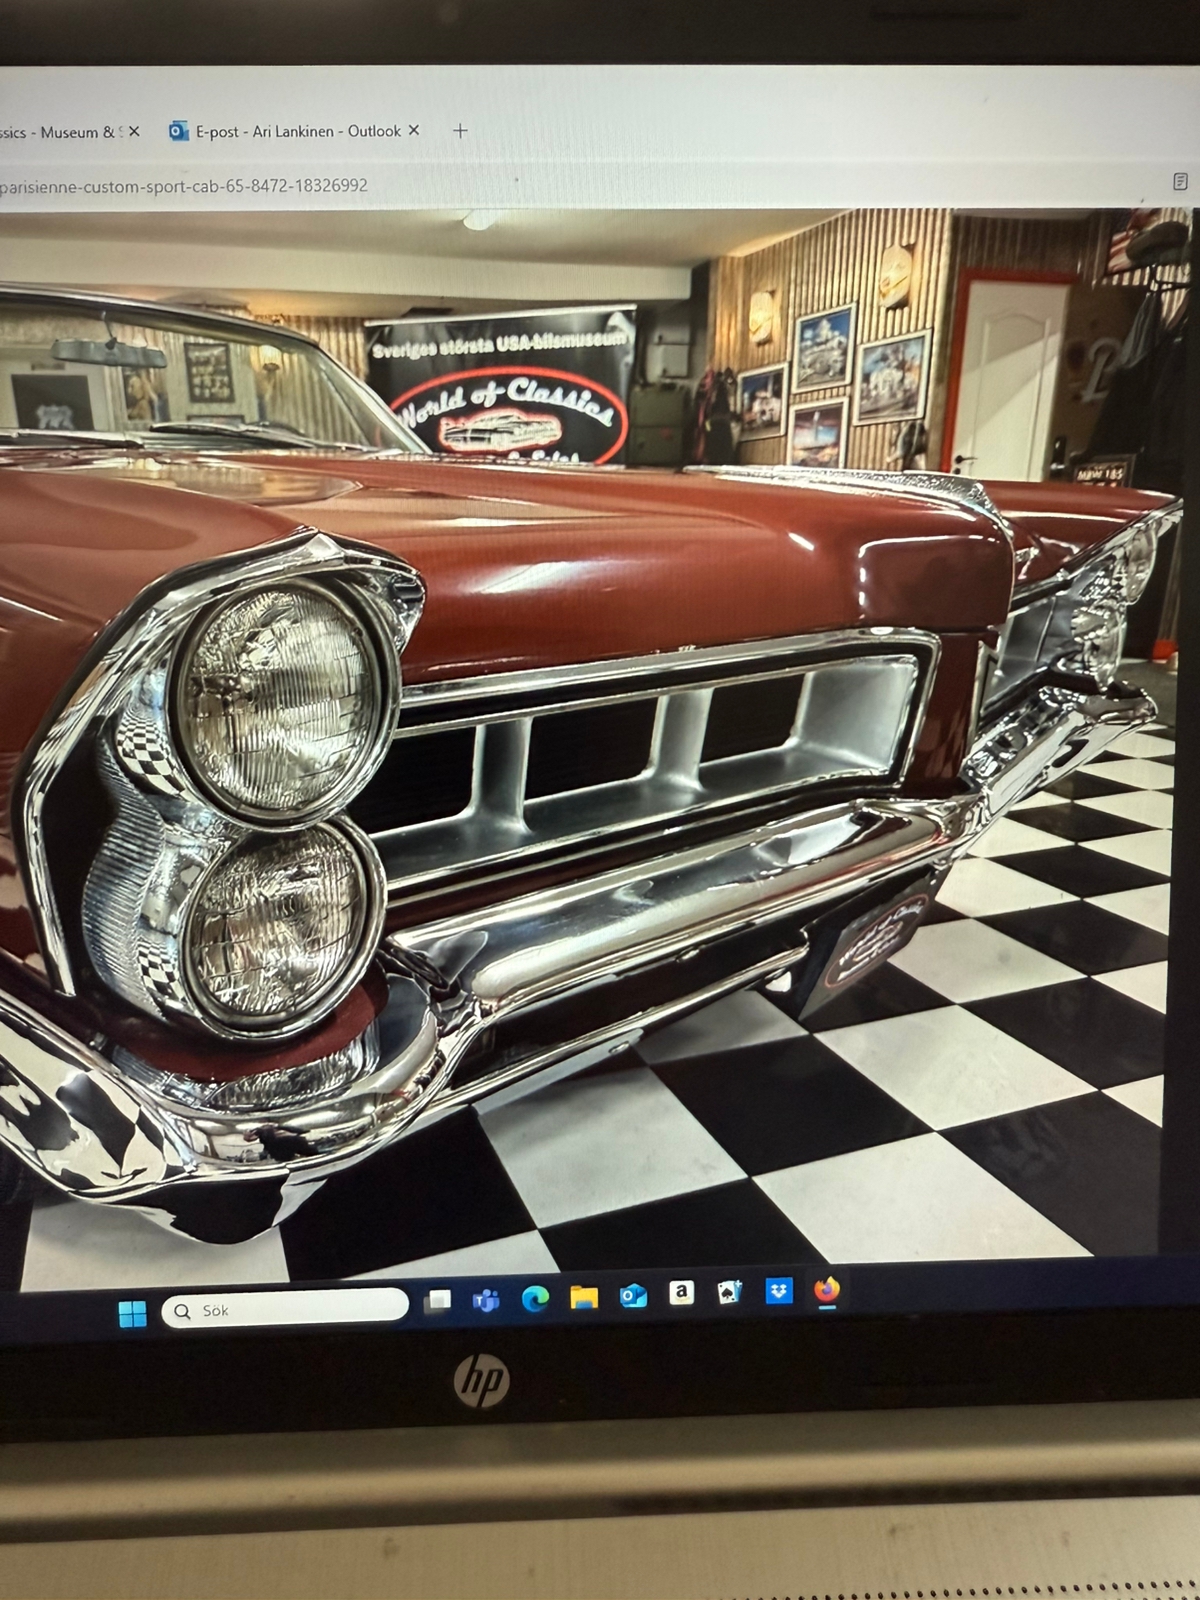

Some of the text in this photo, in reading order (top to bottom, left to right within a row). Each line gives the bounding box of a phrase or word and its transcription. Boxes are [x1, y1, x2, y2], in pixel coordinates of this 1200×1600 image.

[41, 126, 98, 139] Museum
[103, 126, 115, 139] &
[197, 125, 239, 141] E-post
[252, 124, 271, 138] Ari
[275, 125, 334, 138] Lankinen
[348, 124, 402, 138] Outlook
[372, 342, 437, 360] Sveriges
[439, 338, 495, 356] största
[399, 376, 615, 429] World of Classics
[203, 1304, 229, 1317] Sök
[461, 1353, 504, 1408] hp
